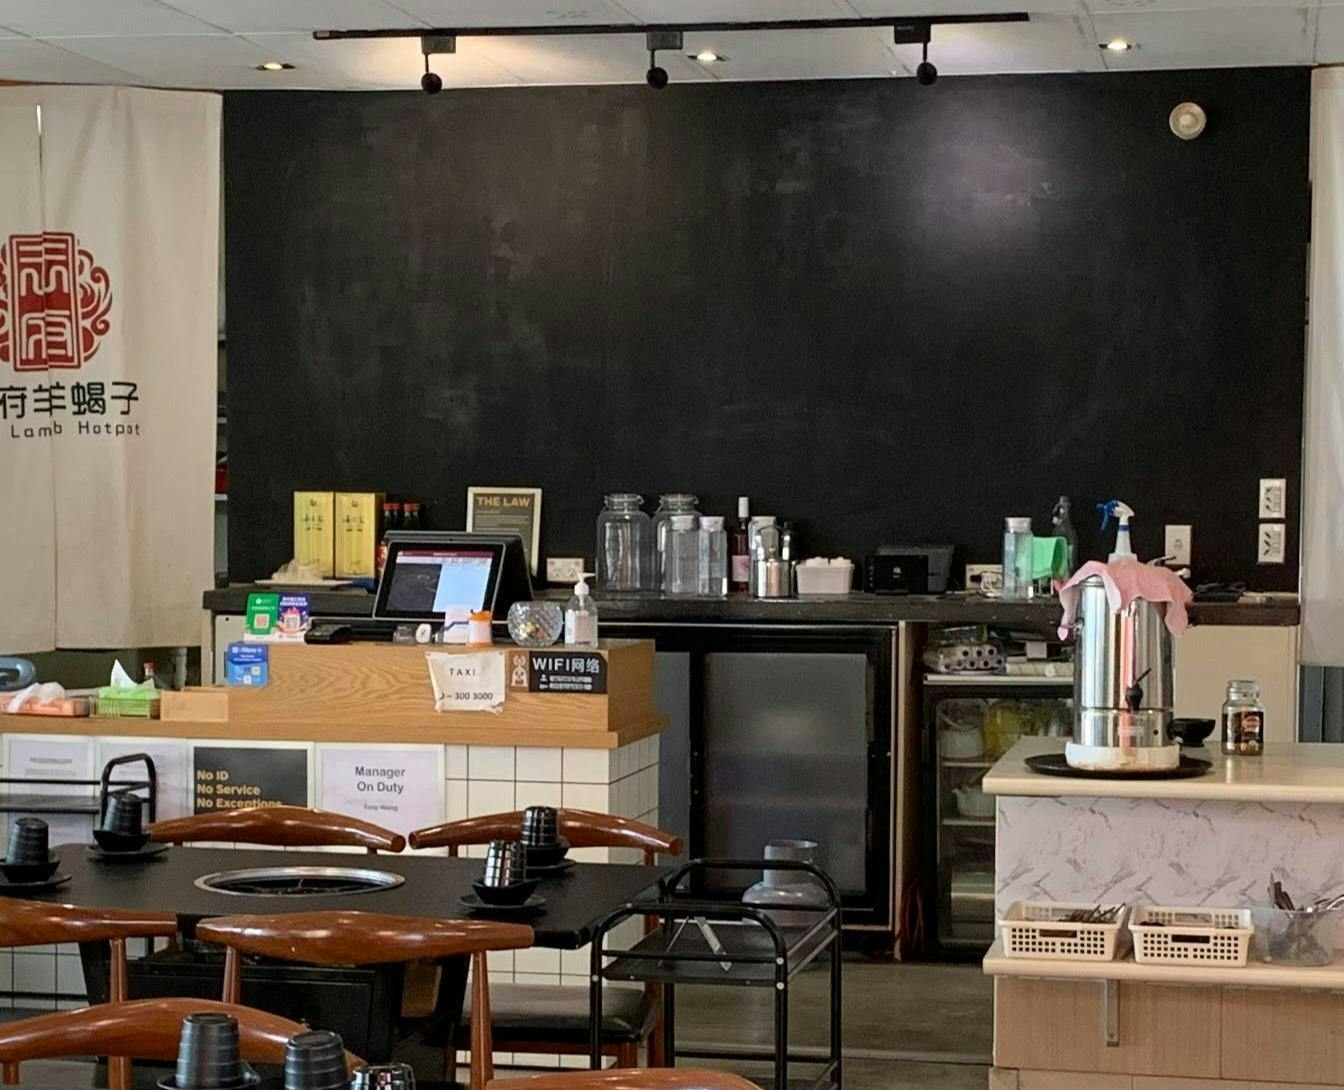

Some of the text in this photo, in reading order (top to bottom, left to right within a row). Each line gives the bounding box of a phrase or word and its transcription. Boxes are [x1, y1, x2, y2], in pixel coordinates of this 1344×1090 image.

[11, 421, 62, 438] Lamb
[78, 420, 141, 437] Hotpot
[477, 497, 530, 507] THE LAW
[197, 770, 229, 781] No ID
[354, 765, 406, 779] Manager
[197, 784, 261, 795] No Service
[356, 781, 404, 795] On Duty
[197, 798, 213, 808] No
